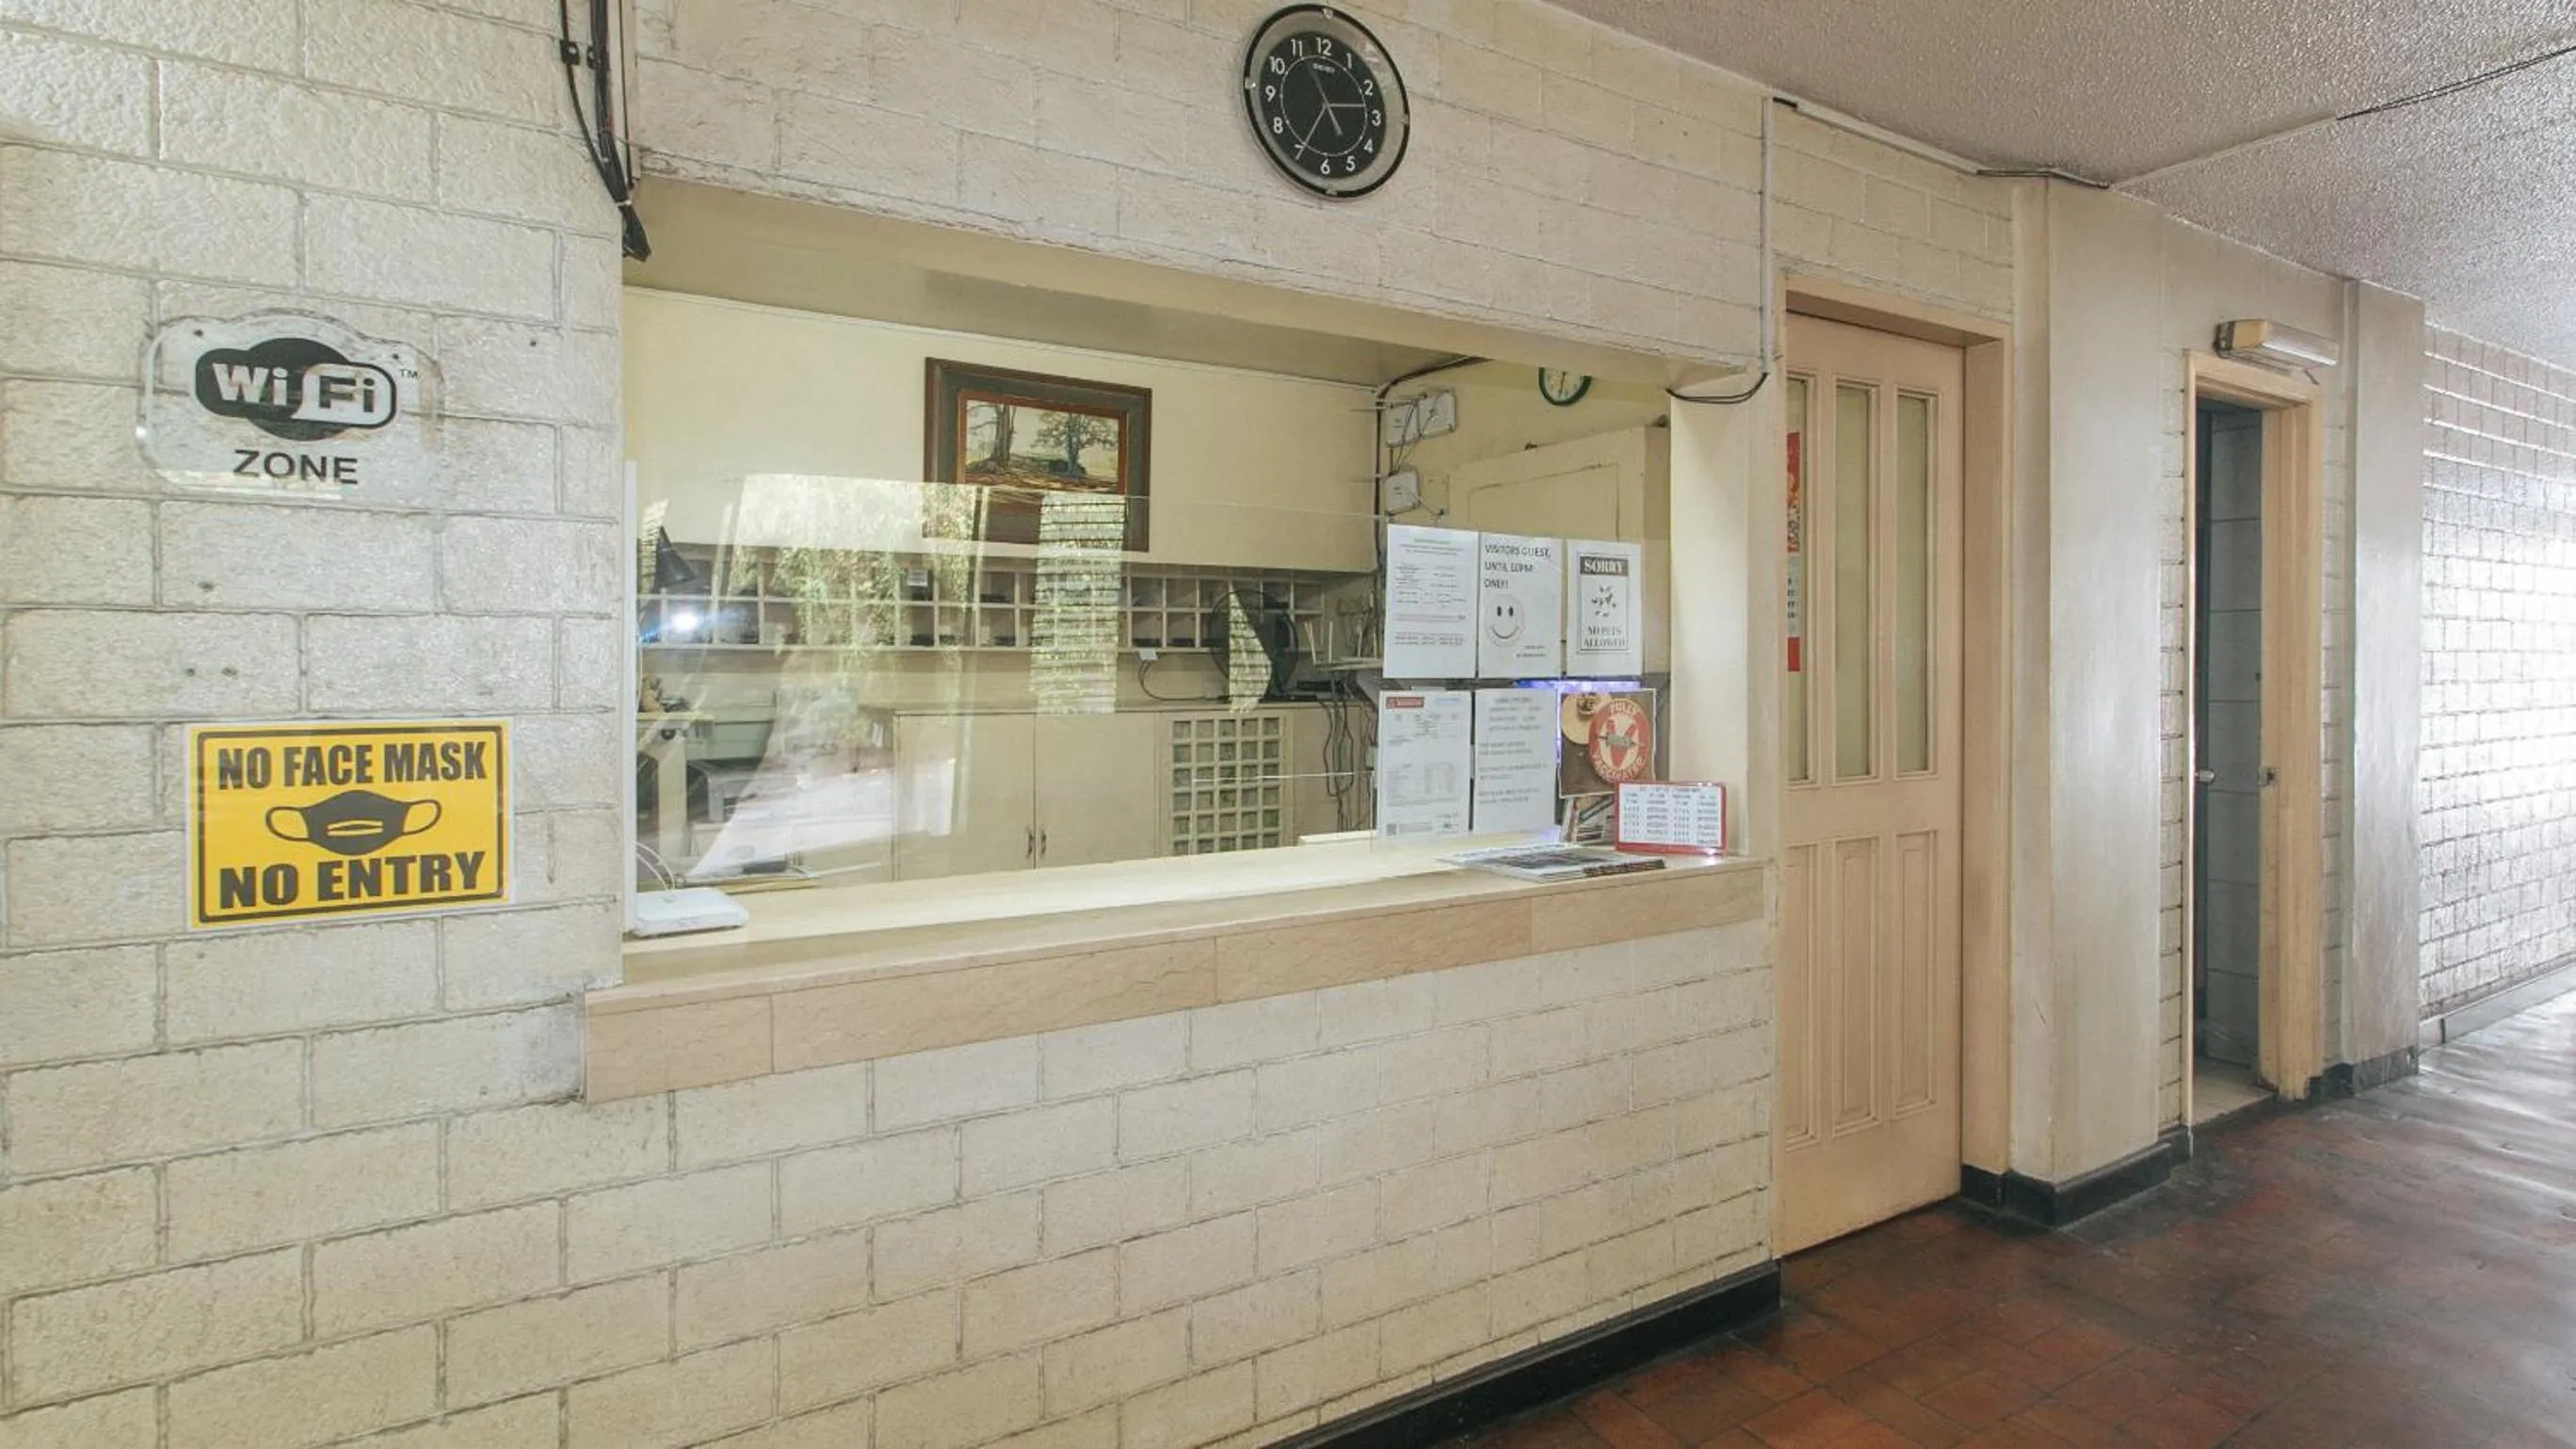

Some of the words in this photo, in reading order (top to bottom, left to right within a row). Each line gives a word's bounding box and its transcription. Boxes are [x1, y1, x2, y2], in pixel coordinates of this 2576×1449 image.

[1291, 39, 1303, 56] 11
[1316, 38, 1331, 56] 12
[1269, 56, 1285, 74] 10
[1346, 53, 1352, 69] 1
[1265, 86, 1276, 102] 9
[1364, 80, 1373, 95] 2
[1273, 117, 1283, 134] 8
[1372, 110, 1381, 126] 3
[1364, 139, 1373, 153] 4
[1320, 158, 1330, 174] 6
[1345, 155, 1356, 171] 5
[233, 449, 358, 485] ZONE
[1585, 558, 1624, 573] SORRY
[217, 748, 272, 790] NO
[283, 744, 374, 787] FACE
[383, 741, 487, 783] MASK
[219, 863, 299, 909] NO
[317, 851, 486, 902] ENTRY
